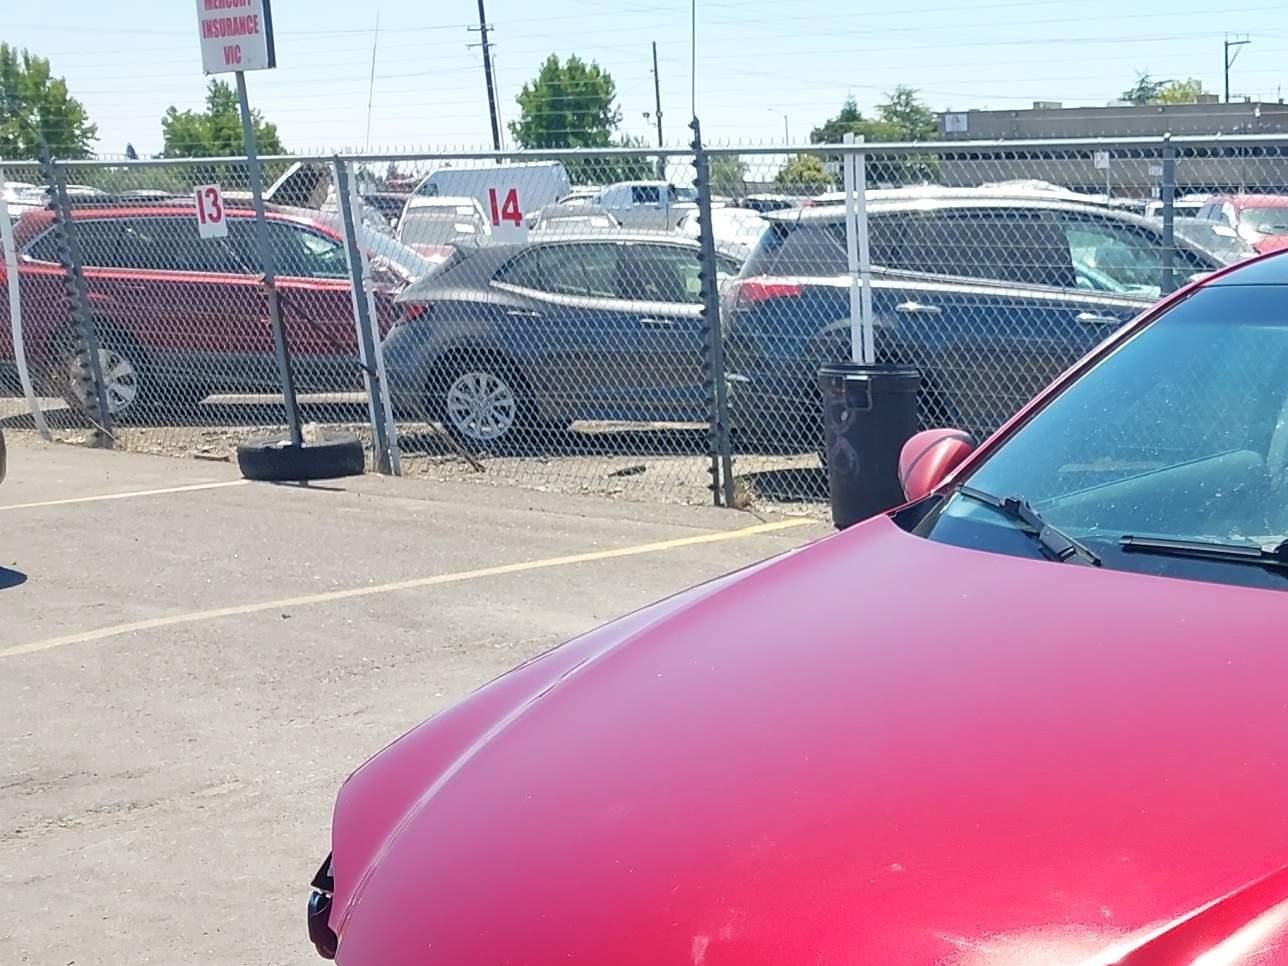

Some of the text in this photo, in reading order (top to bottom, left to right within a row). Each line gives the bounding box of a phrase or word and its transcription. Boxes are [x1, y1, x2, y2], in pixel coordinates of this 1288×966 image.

[202, 14, 259, 39] INSURANCE
[224, 45, 242, 64] VIC
[196, 188, 222, 224] 13
[489, 188, 522, 227] 14
